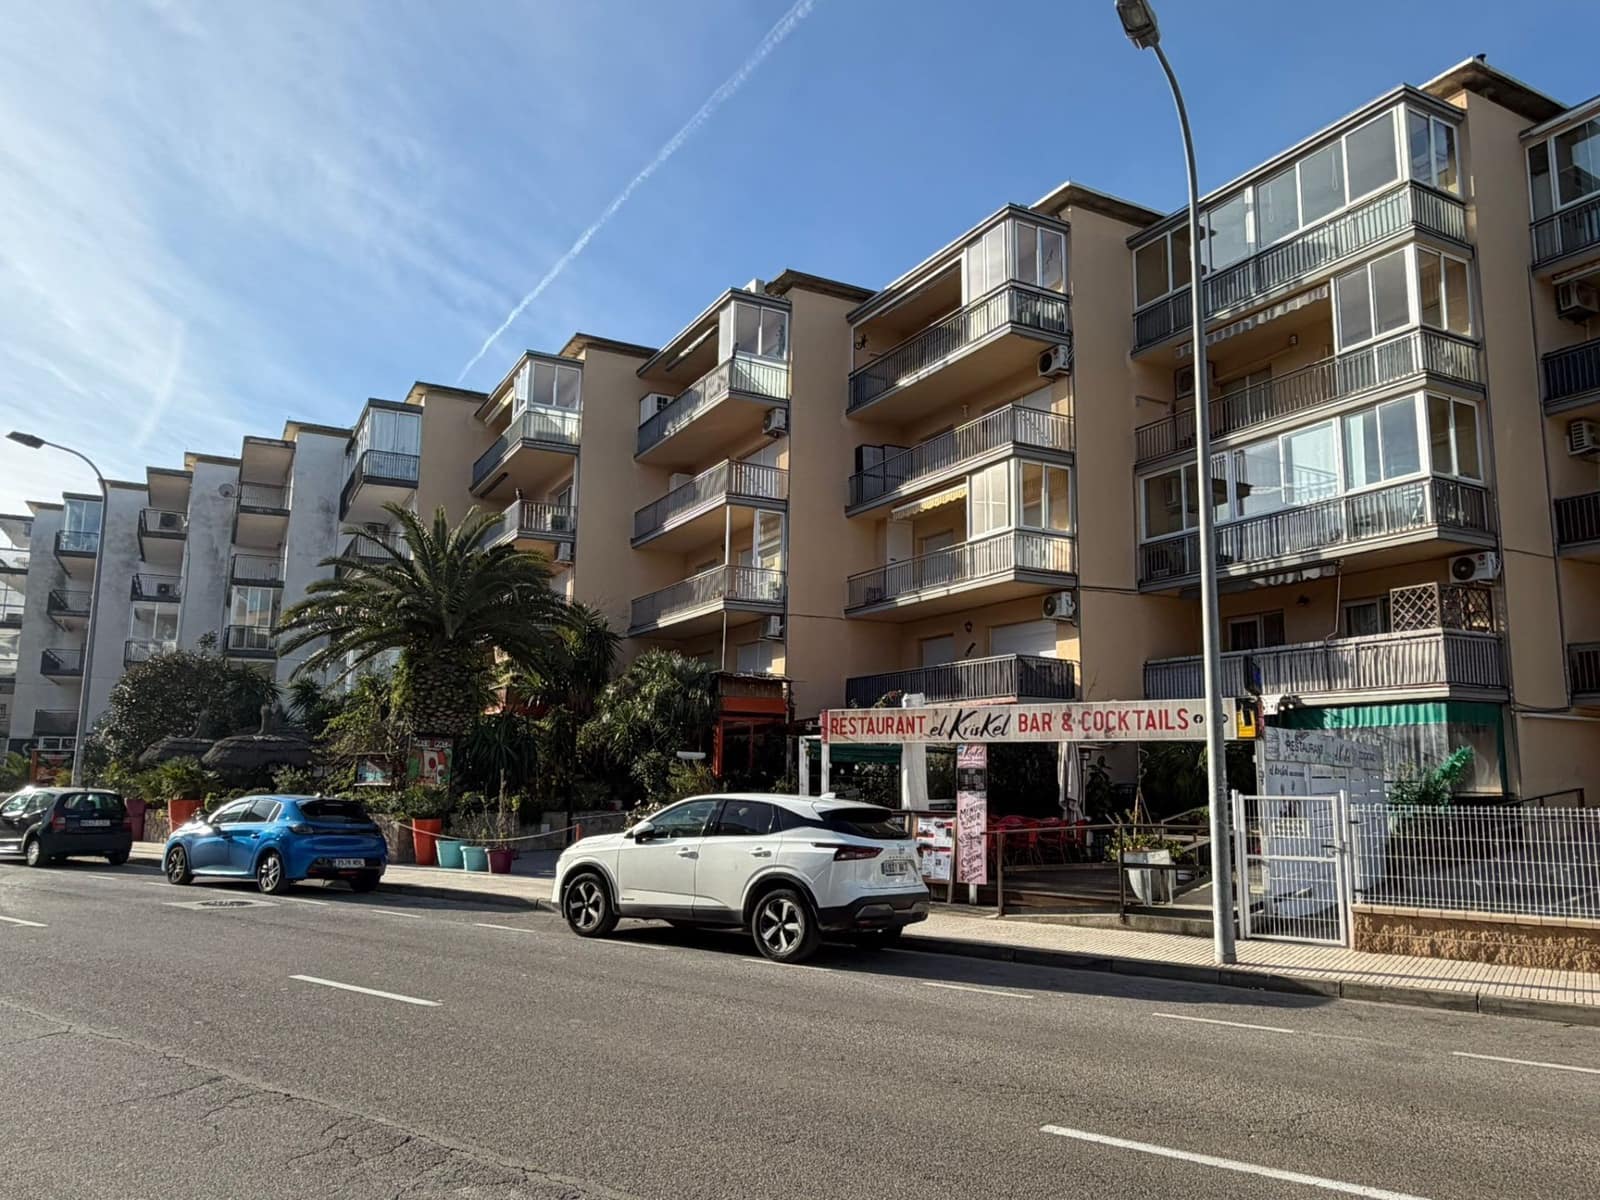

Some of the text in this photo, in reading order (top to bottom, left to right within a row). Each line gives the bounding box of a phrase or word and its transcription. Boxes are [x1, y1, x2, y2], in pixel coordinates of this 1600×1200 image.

[831, 707, 1189, 740] RESTAURANT el KrisKel BAR & COCKTAILS
